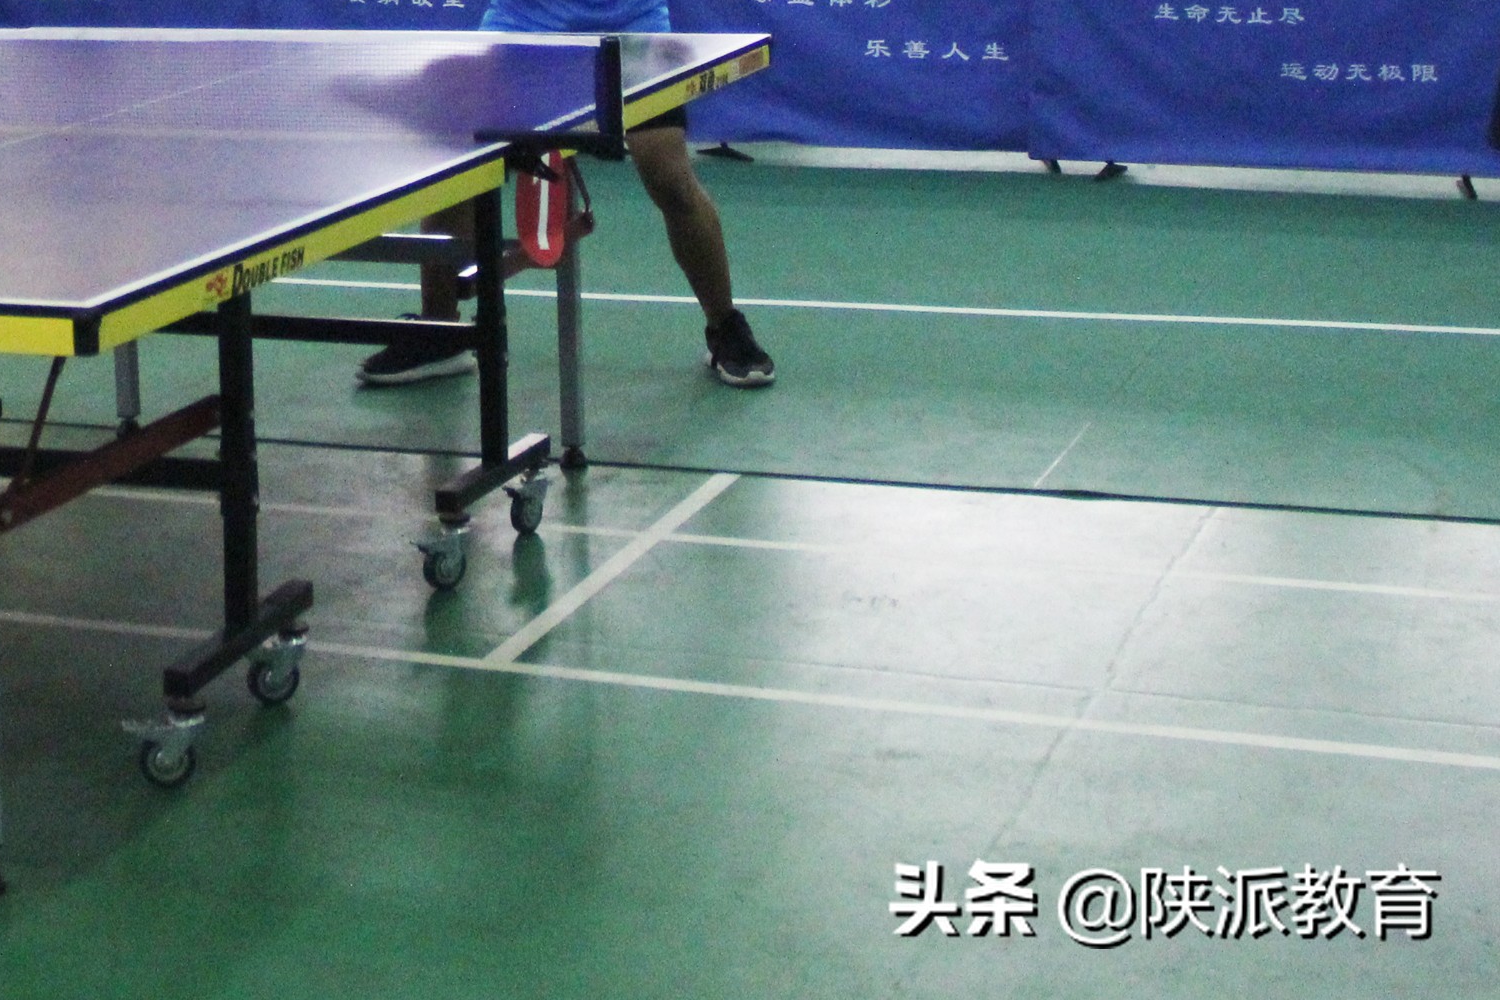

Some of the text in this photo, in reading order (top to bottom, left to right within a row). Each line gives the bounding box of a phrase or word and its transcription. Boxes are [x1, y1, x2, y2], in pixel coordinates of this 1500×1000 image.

[1154, 2, 1305, 25] 生命无止尽
[864, 39, 1010, 62] 乐善人生
[1280, 61, 1438, 83] 运动无极限
